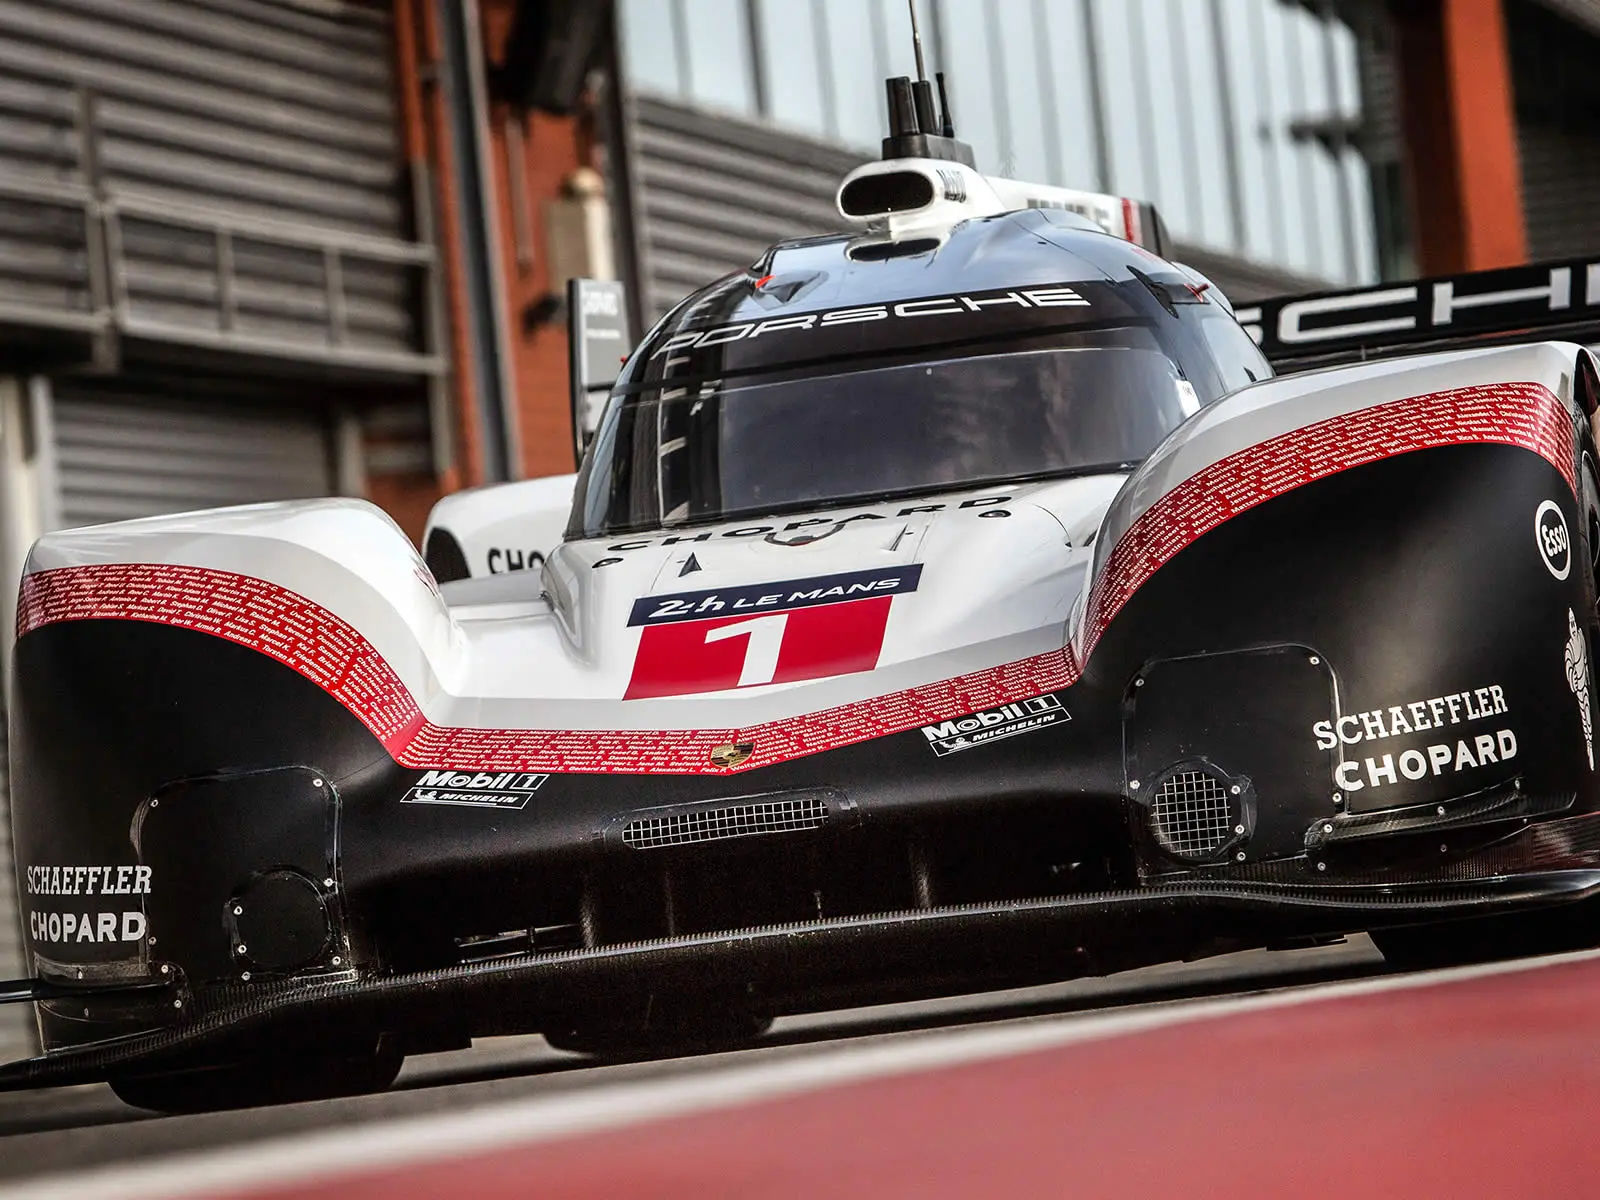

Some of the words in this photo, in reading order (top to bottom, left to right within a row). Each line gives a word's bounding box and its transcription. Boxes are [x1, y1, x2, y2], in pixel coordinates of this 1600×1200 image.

[651, 286, 1091, 361] PORSCHE
[607, 496, 1012, 552] CHOPARD
[1541, 524, 1568, 557] Esso
[733, 593, 784, 609] LE
[787, 578, 901, 602] MANS
[704, 613, 789, 687] 1
[921, 704, 1025, 741] Mobil
[1032, 697, 1049, 709] 1
[972, 714, 1055, 741] MICHELIN
[1312, 684, 1509, 751] SCHAEFFLER
[1335, 728, 1518, 792] CHOPARD
[416, 770, 516, 789] Mobil
[522, 775, 536, 787] 1
[439, 793, 519, 803] MICHELIN
[27, 865, 152, 895] SCHAEFFLER
[30, 910, 147, 943] CHOPARD
